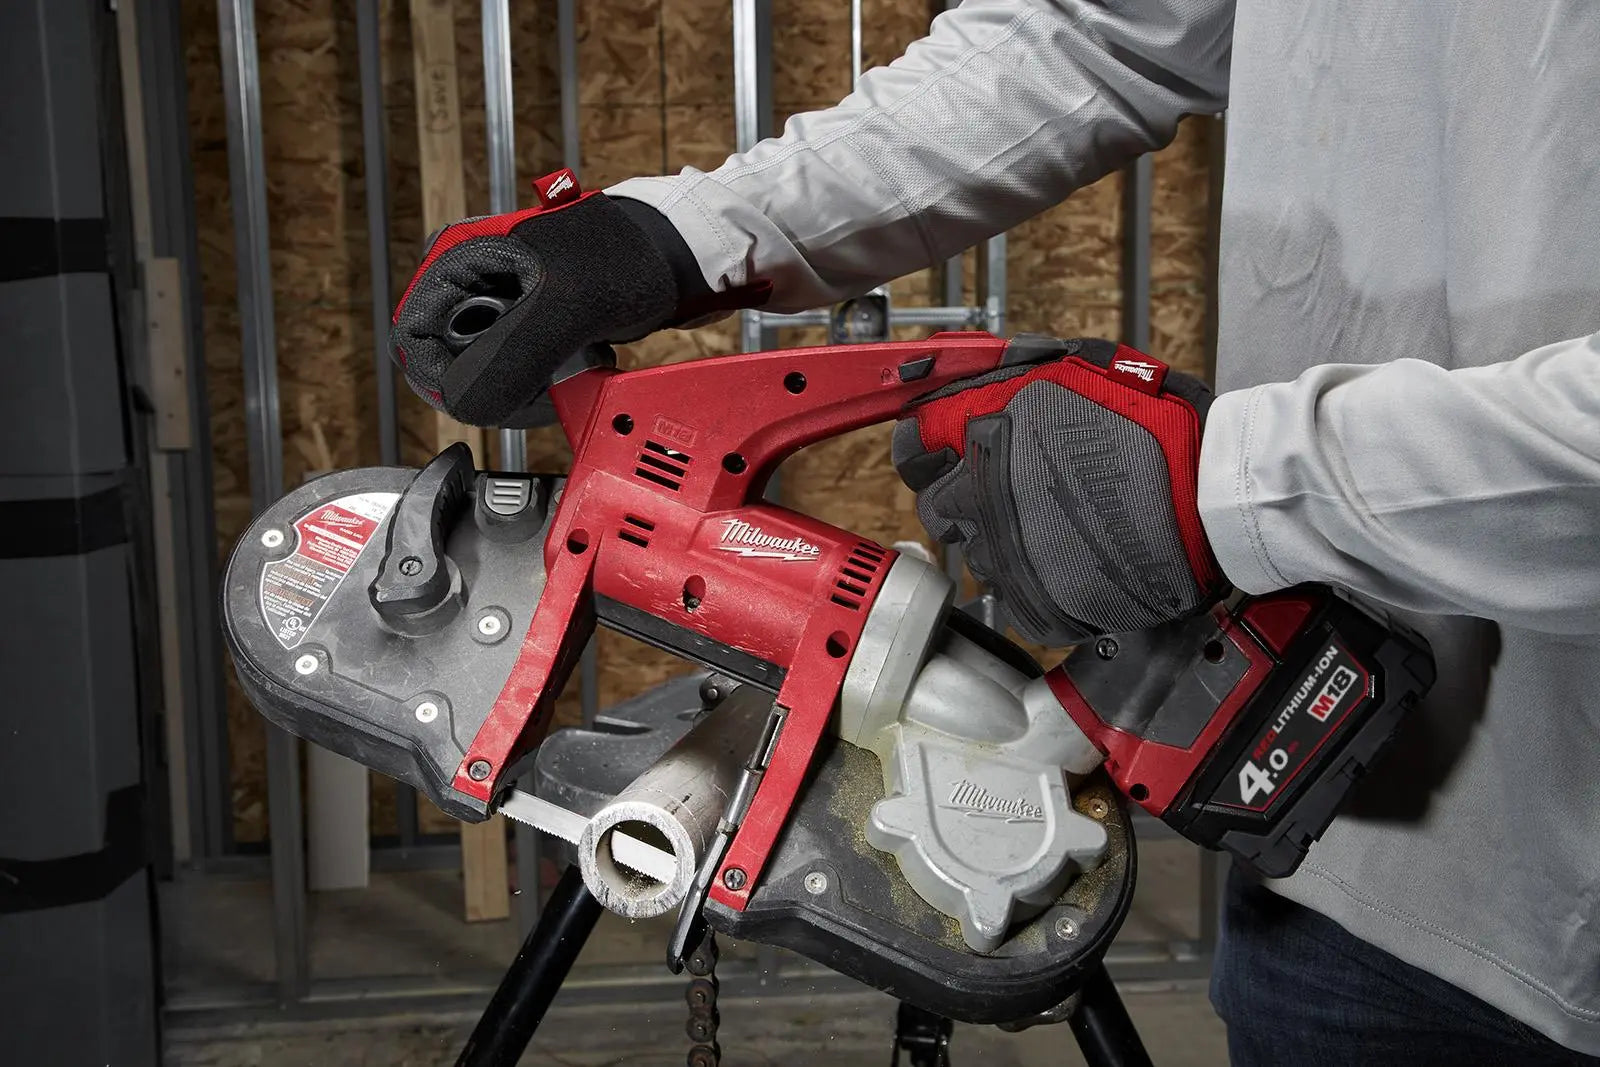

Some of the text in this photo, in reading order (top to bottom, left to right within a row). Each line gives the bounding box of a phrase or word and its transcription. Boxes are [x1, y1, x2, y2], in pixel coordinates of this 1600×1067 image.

[720, 519, 820, 555] Milwaukee
[1310, 667, 1354, 719] M18
[948, 779, 1043, 818] Milwaukee
[1238, 748, 1289, 805] 4.0
